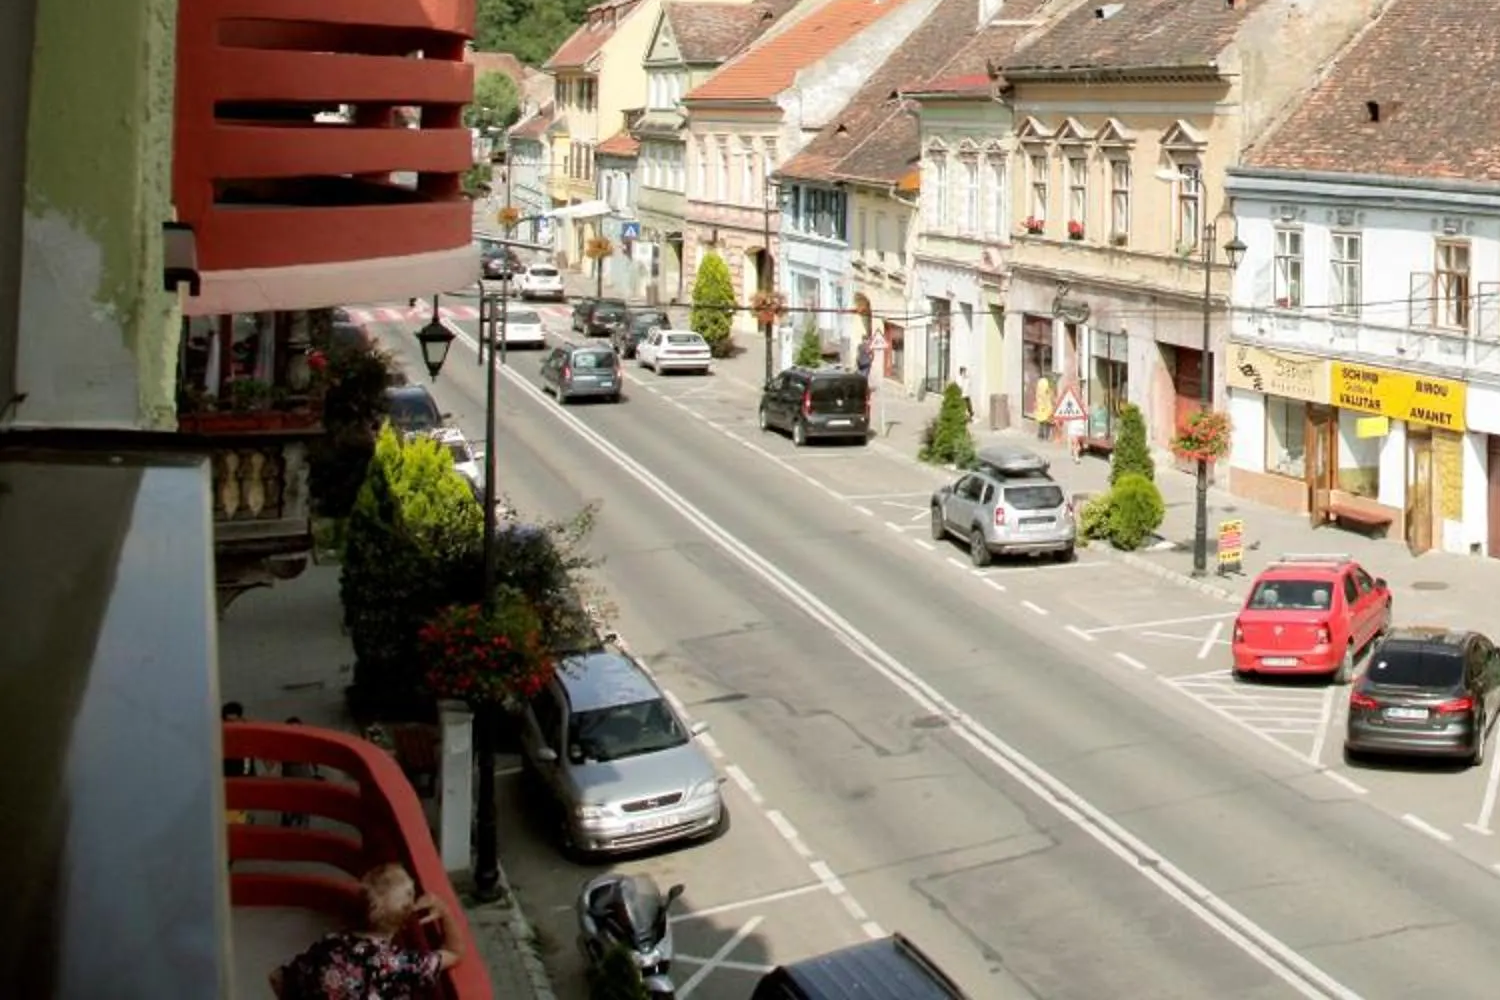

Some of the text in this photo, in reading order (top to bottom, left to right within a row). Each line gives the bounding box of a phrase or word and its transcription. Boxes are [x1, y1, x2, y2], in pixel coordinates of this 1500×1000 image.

[1415, 380, 1449, 397] BIROU
[1340, 393, 1381, 409] VALUTAR
[1409, 407, 1453, 425] AMANET
